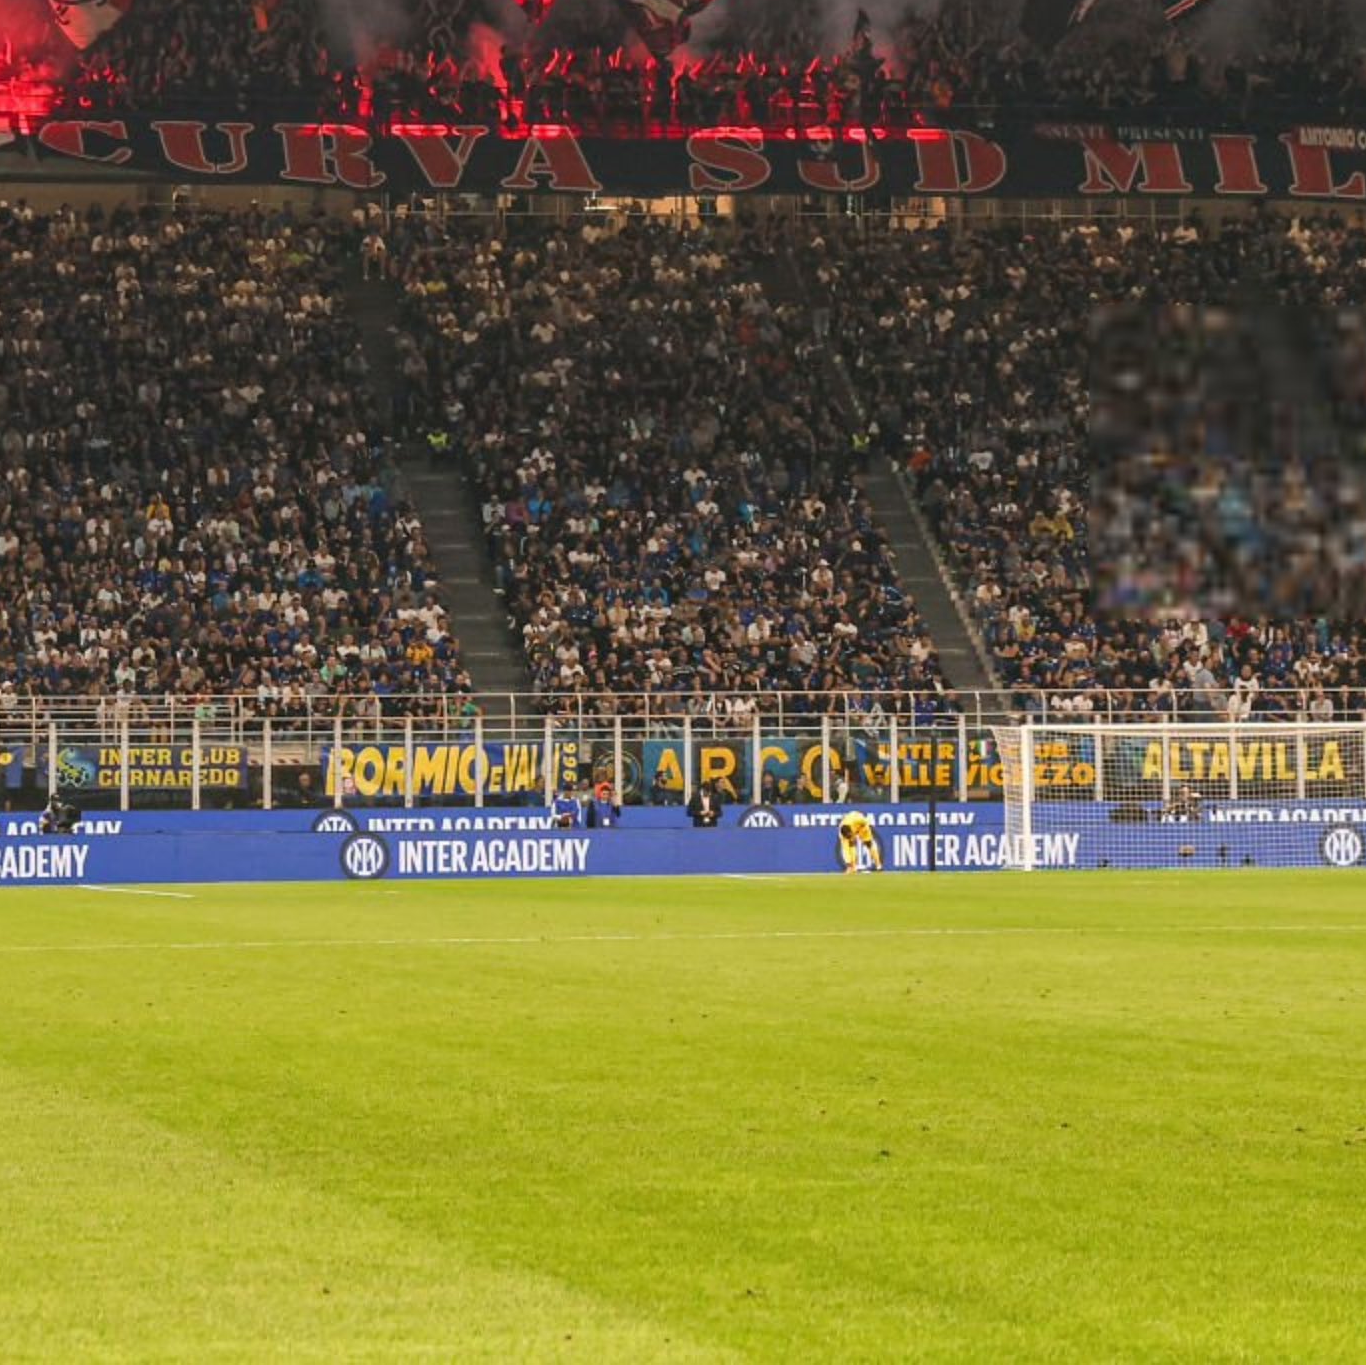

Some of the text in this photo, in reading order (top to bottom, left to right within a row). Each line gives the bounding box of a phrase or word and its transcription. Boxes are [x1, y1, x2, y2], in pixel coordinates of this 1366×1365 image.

[38, 120, 602, 192] CURVA
[685, 126, 1007, 193] SUD
[99, 747, 241, 766] INTER CLUB
[325, 744, 489, 796] BORMIO
[1142, 741, 1346, 782] ALTAVILLA
[98, 768, 241, 787] CORNAREDO
[398, 838, 591, 874] INTER ACADEMY
[893, 833, 1080, 867] INTER ACADEMY
